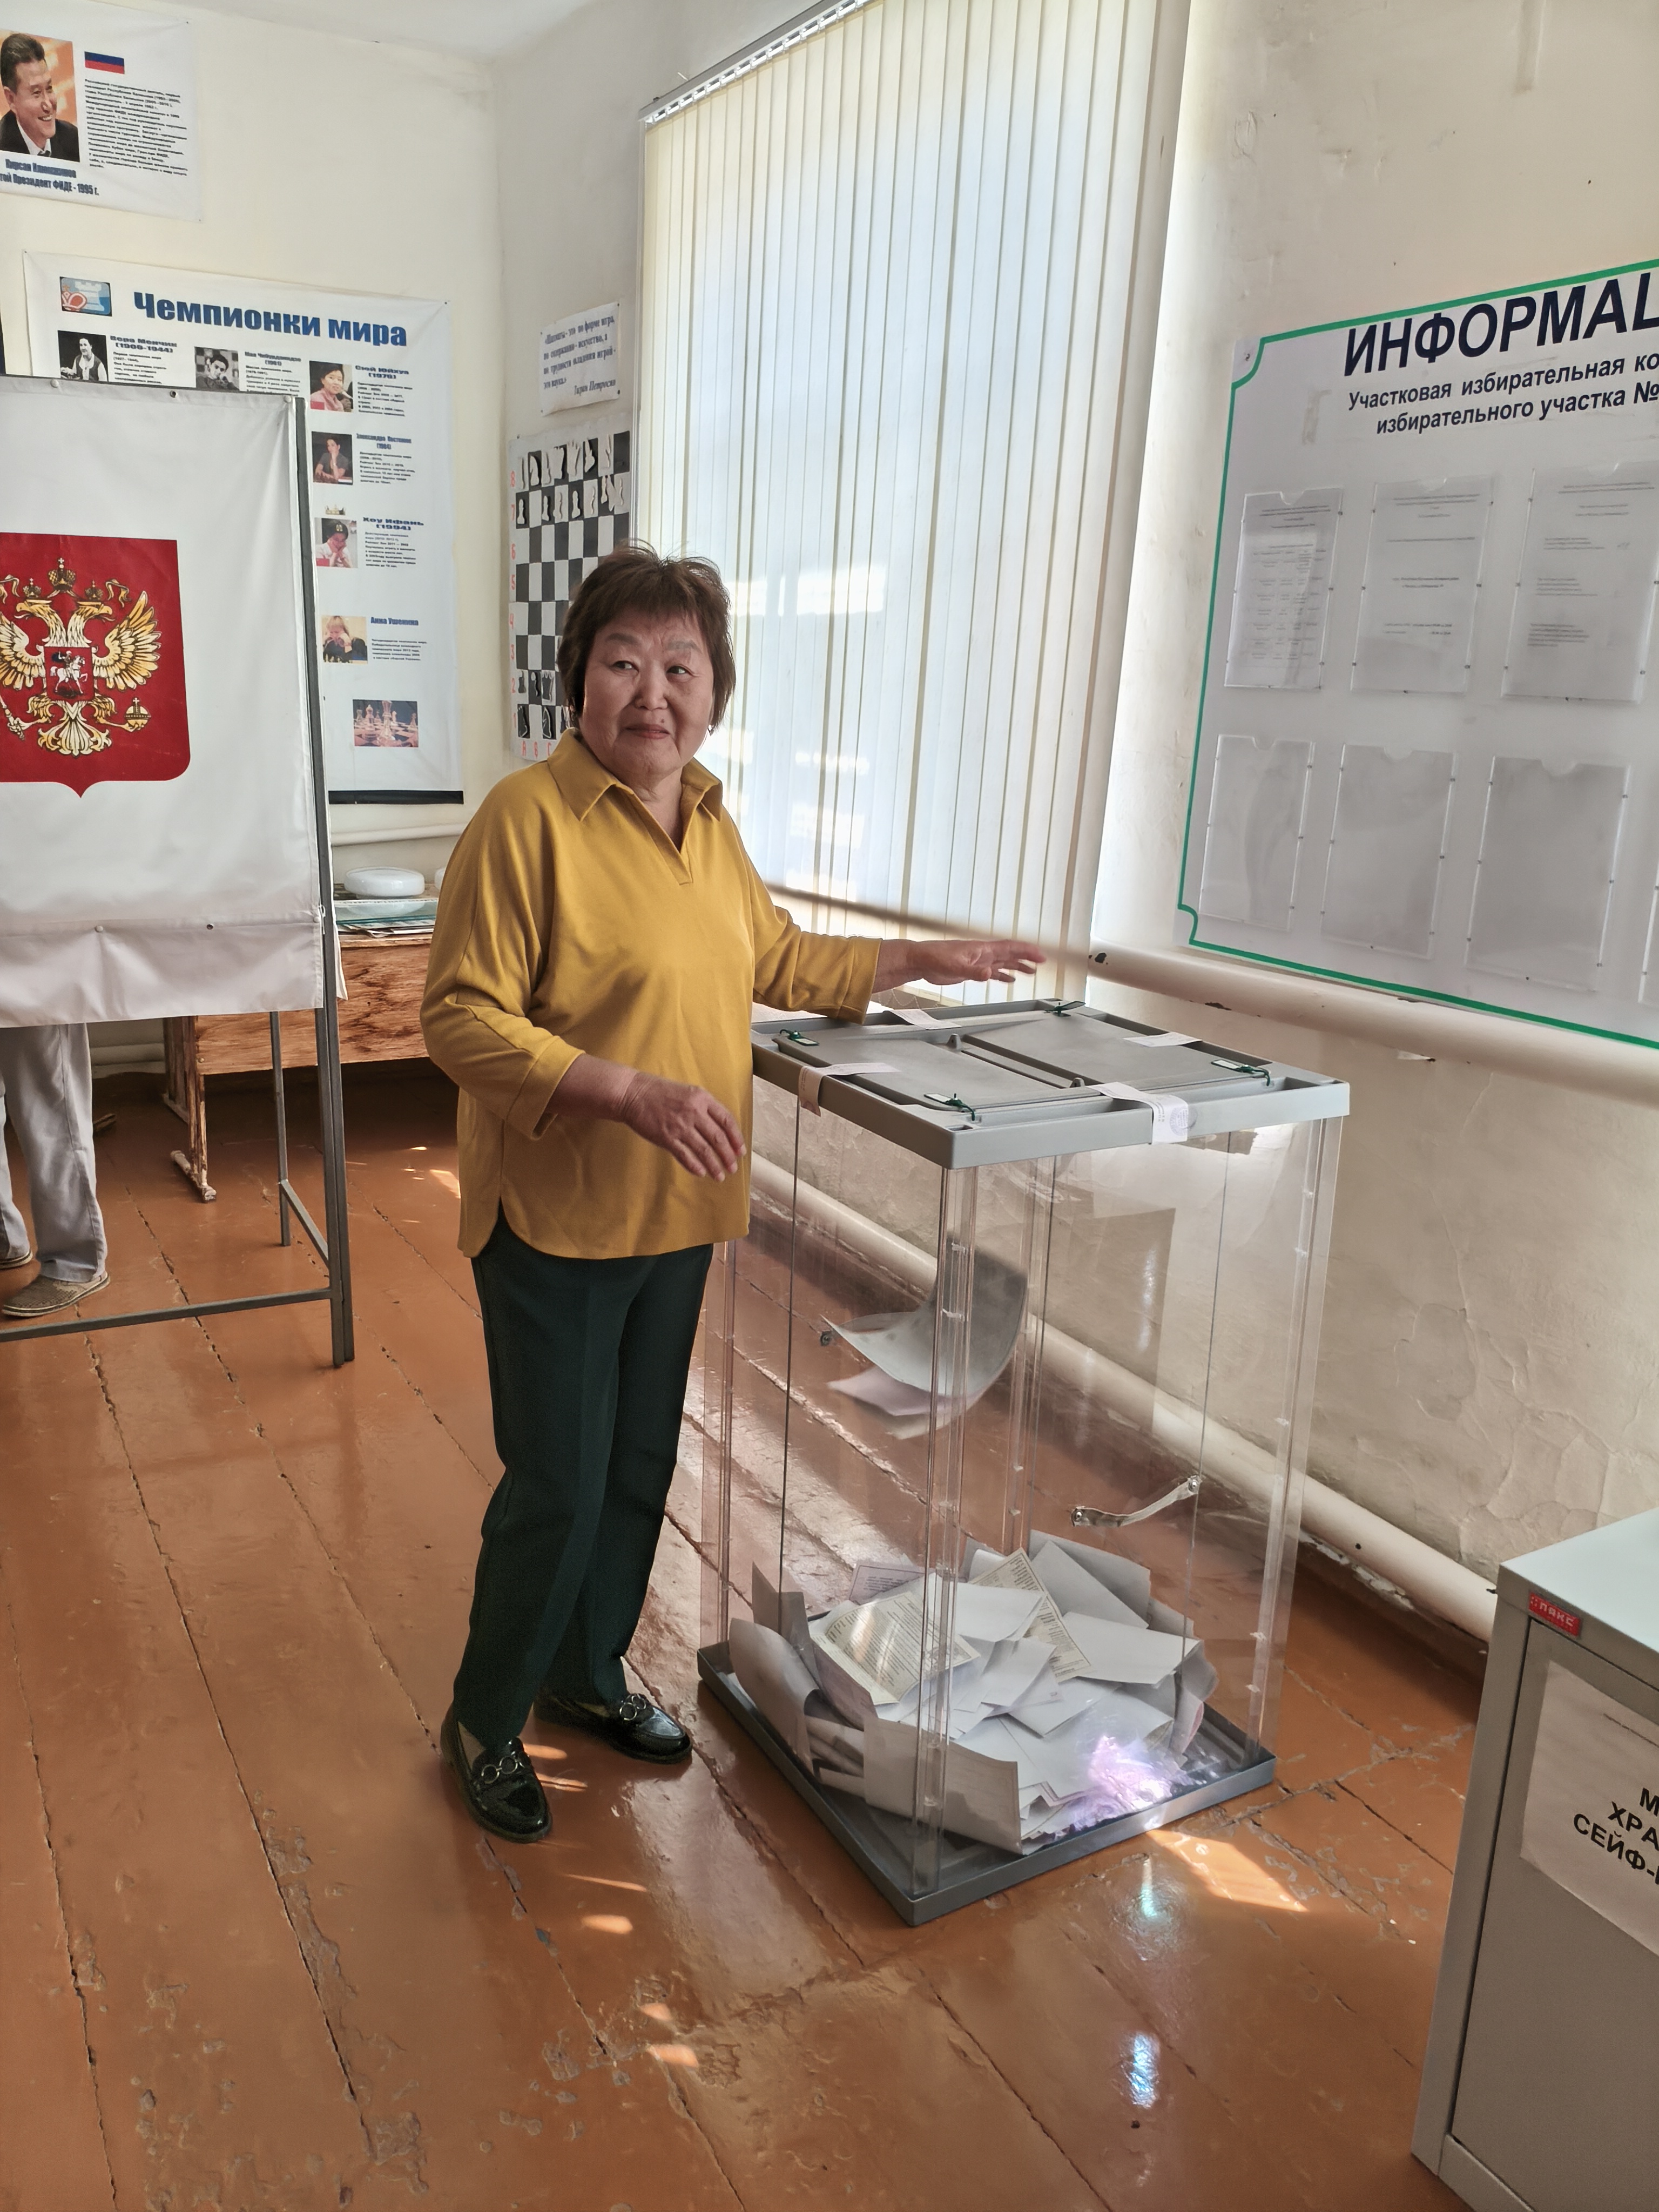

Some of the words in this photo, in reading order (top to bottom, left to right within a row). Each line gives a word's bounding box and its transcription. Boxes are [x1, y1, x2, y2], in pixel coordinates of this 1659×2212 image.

[13, 173, 51, 188] Президент
[53, 179, 72, 192] ФИДЕ
[77, 183, 93, 195] 1995
[134, 292, 320, 337] Чемпионки
[328, 319, 407, 346] мира
[1349, 383, 1452, 410] Участковая
[1461, 358, 1625, 395] избирательная
[1635, 353, 1659, 372] ко
[1377, 402, 1534, 434] избирательного
[1539, 389, 1626, 421] участка
[1634, 381, 1659, 404] №
[1608, 1801, 1659, 1851] ХРА
[1640, 1788, 1659, 1817] М
